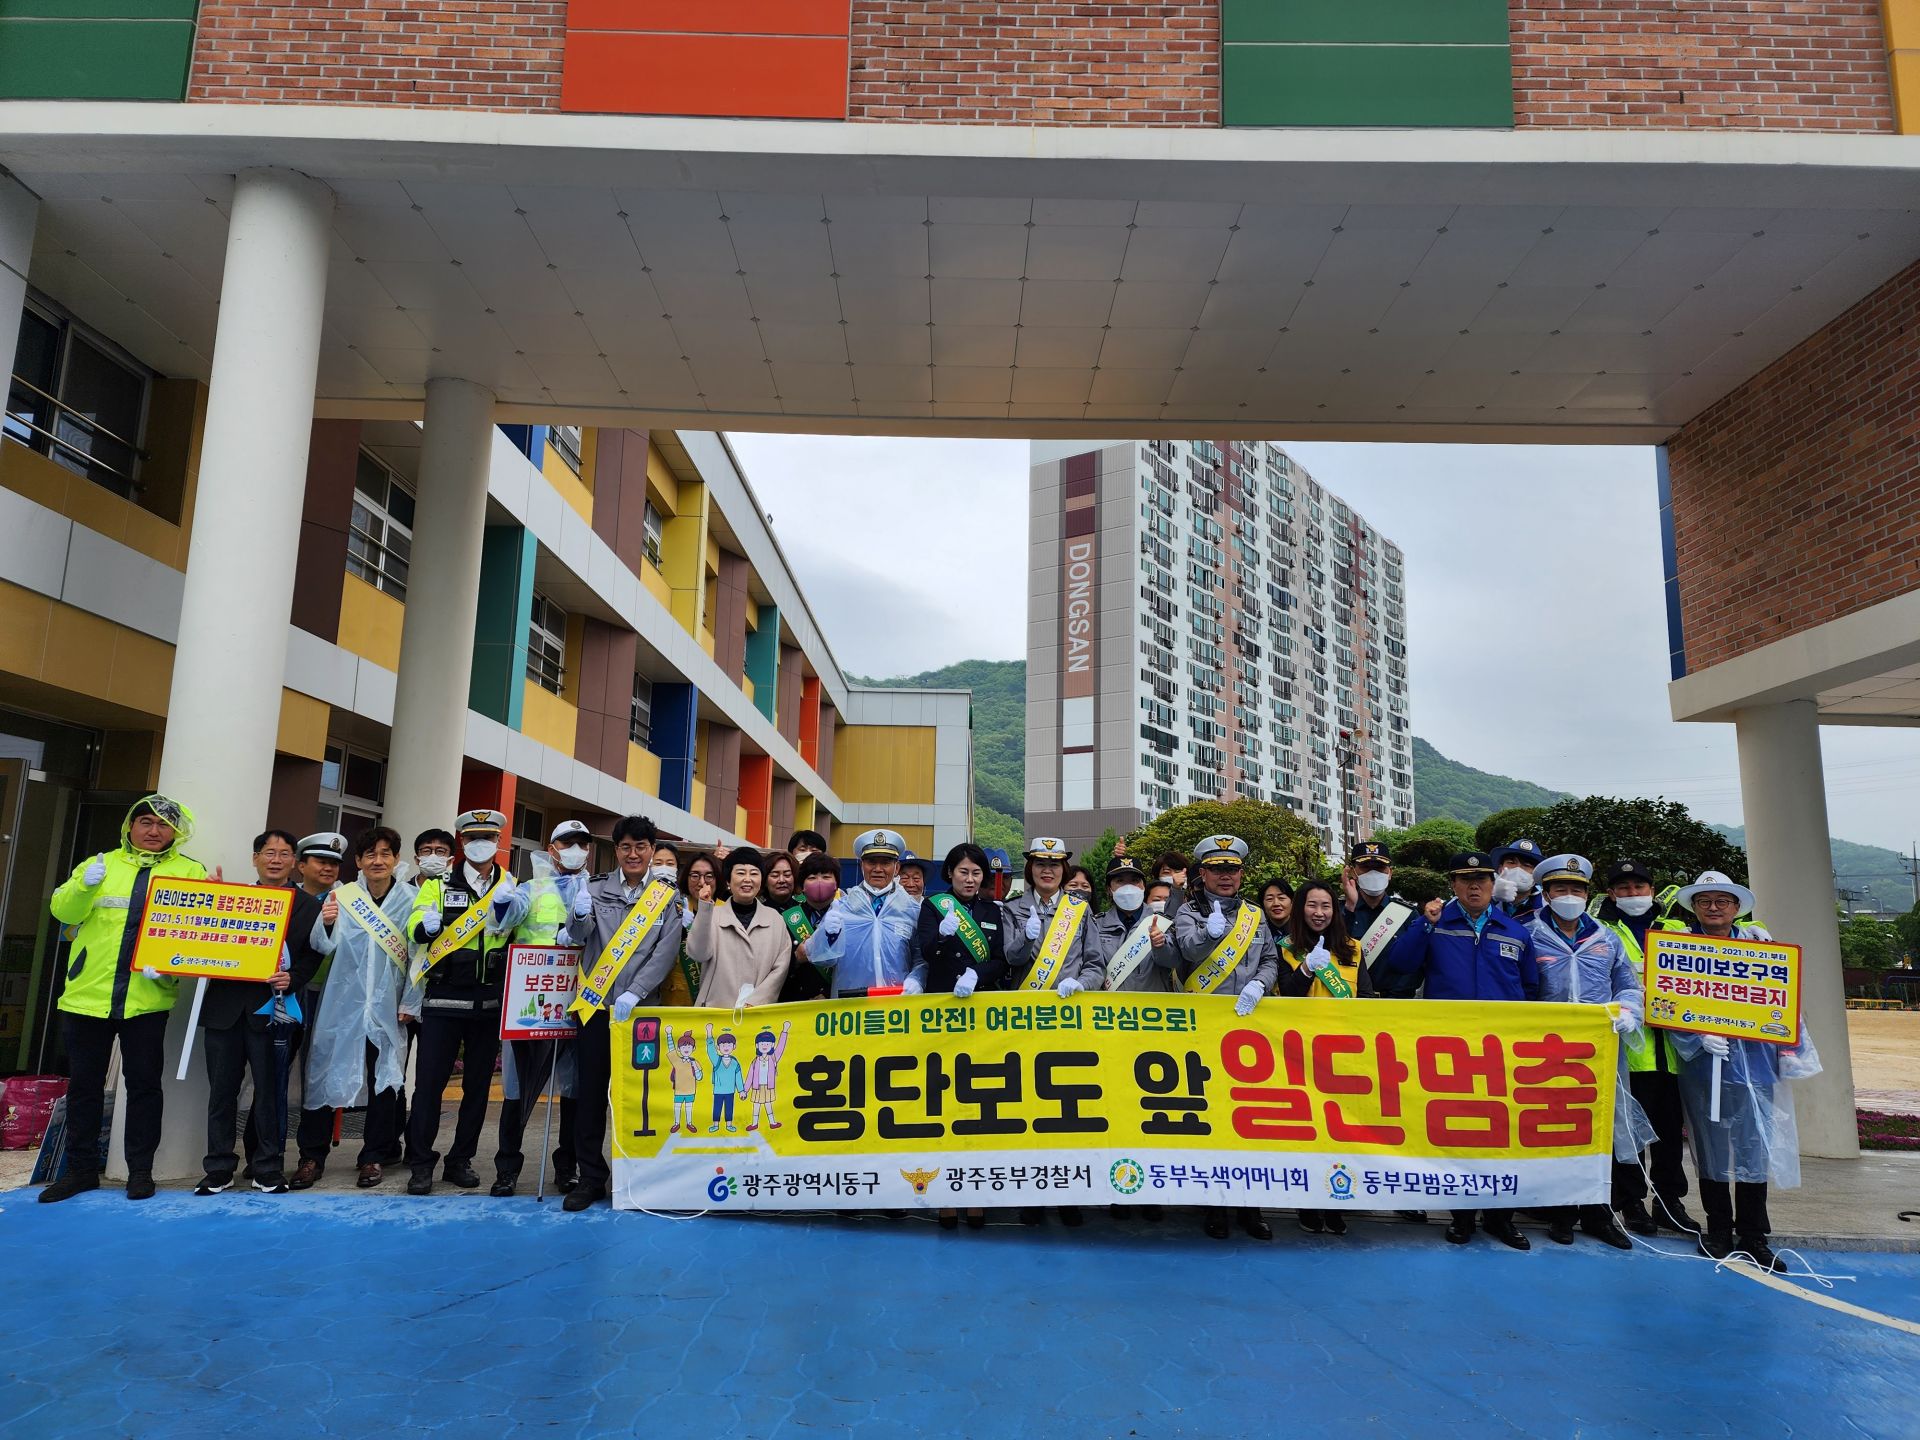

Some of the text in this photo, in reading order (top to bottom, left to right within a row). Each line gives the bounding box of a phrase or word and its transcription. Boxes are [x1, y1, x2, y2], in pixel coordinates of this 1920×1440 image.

[1068, 543, 1091, 672] DONGSAN
[154, 888, 284, 916] 어린이보호구역 불법 주정차 금지!
[150, 912, 276, 932] 2021.5.11일부터 어린이보호구역
[430, 910, 488, 958] 어린이 보호
[148, 928, 167, 938] 불법
[169, 930, 198, 940] 주정차
[200, 932, 228, 943] 과태료
[250, 936, 274, 946] 부과!
[611, 914, 646, 961] 보호구역
[1658, 941, 1697, 951] 도로교통법
[1199, 914, 1254, 989] 어린이 보호구역
[594, 965, 614, 989] 서행
[1030, 958, 1055, 990] 어린이
[1658, 953, 1788, 984] 어린이보호구역
[1657, 975, 1787, 1007] 주정차전면금지
[815, 1004, 1197, 1036] 아이들의 안전! 여러분의 관심으로!
[1698, 1014, 1756, 1029] 광주광역시동구
[792, 1029, 1598, 1148] 횡단보도 앞 일단멈춤
[742, 1172, 880, 1197] 광주광역시동구
[946, 1166, 1092, 1192] 광주동부경찰서
[1149, 1165, 1309, 1192] 동부녹색어머니회
[1363, 1170, 1519, 1196] 동부모범운전자회
